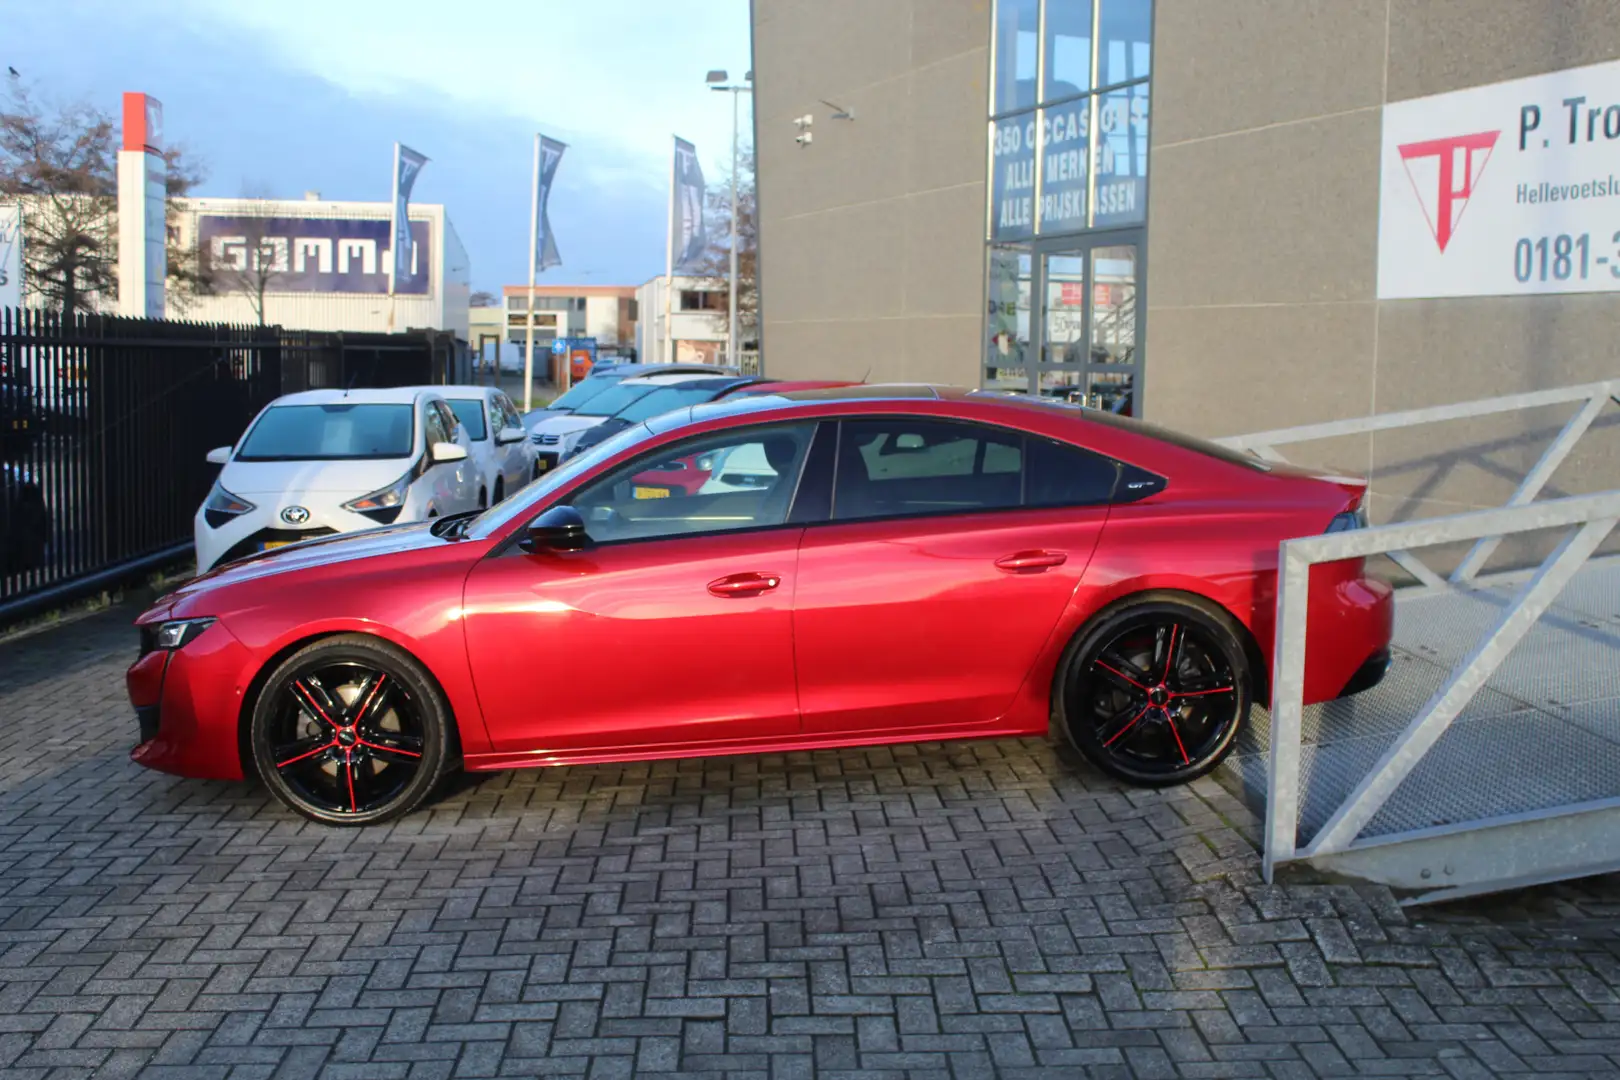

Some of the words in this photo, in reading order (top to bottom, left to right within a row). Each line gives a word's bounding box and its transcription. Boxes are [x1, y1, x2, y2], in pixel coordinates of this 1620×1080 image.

[994, 125, 1022, 157] 350
[1025, 96, 1145, 149] OCCASONS
[1518, 104, 1550, 152] P.
[1562, 96, 1620, 145] Tro
[999, 196, 1032, 228] ALLE
